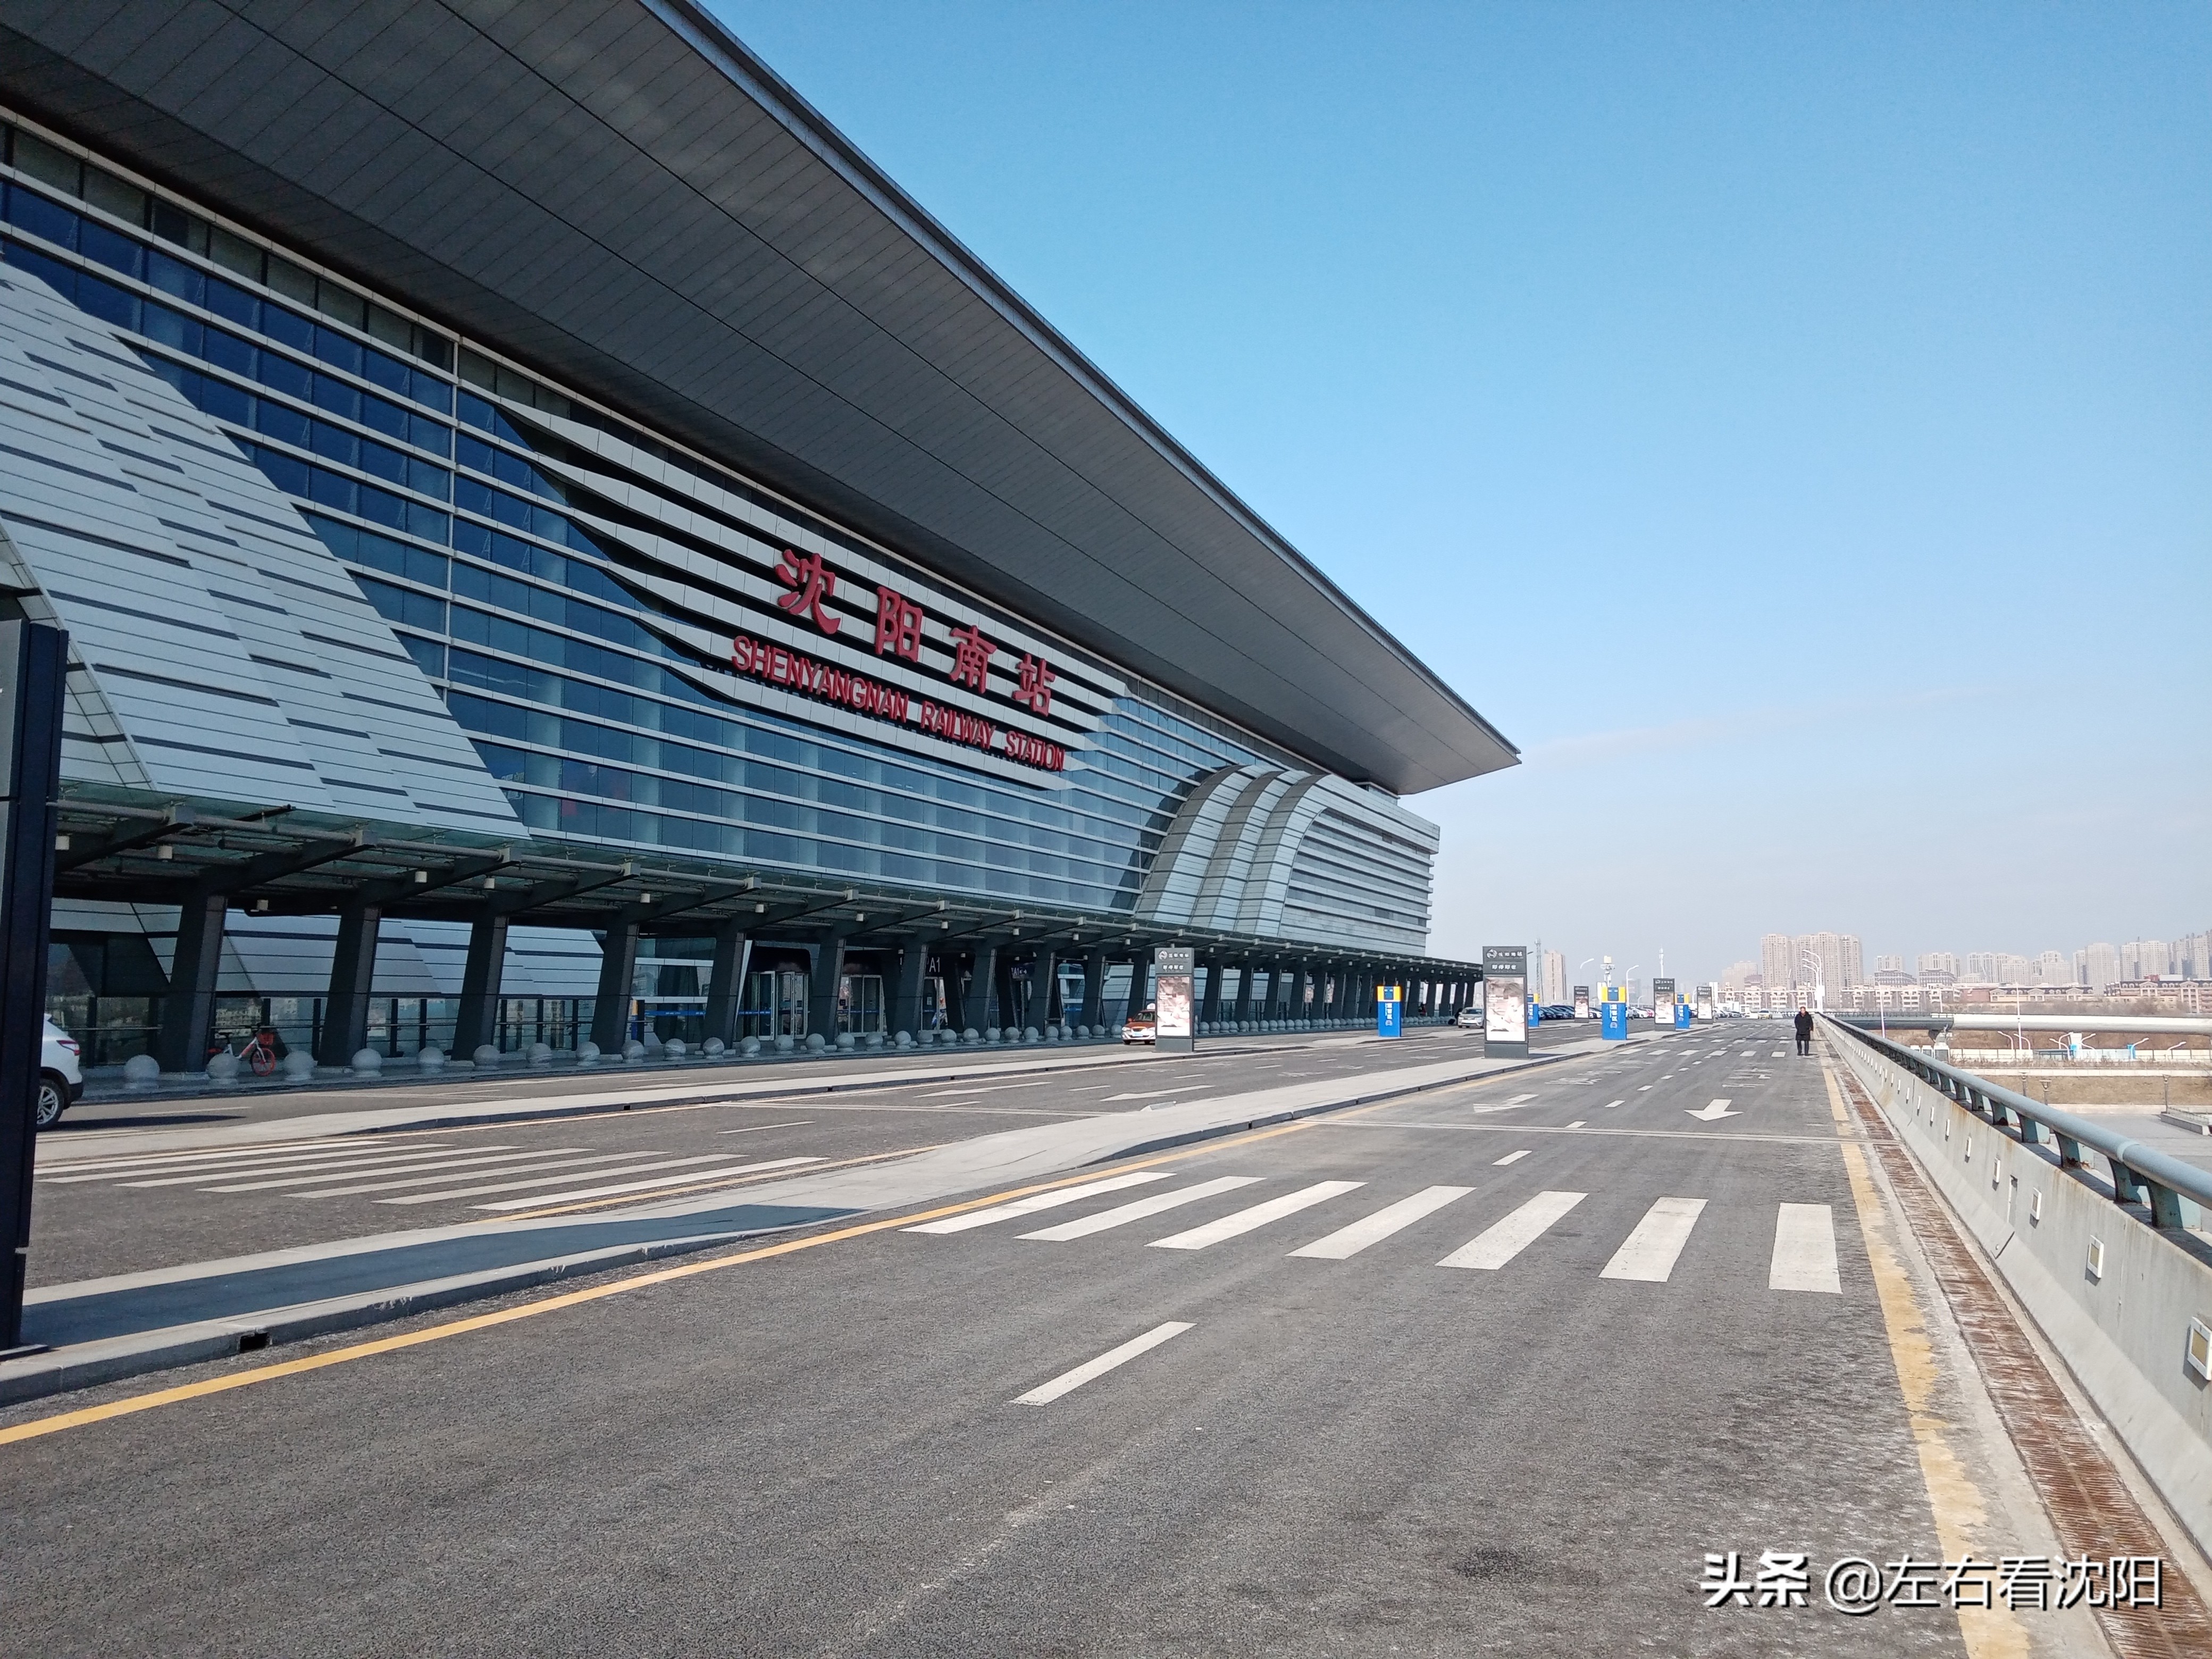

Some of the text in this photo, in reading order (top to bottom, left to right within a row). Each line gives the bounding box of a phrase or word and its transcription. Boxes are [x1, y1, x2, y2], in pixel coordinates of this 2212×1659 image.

[731, 635, 1065, 772] SHENYANGNAN RAILWAY STATION
[775, 549, 1055, 716] 沈阳南站
